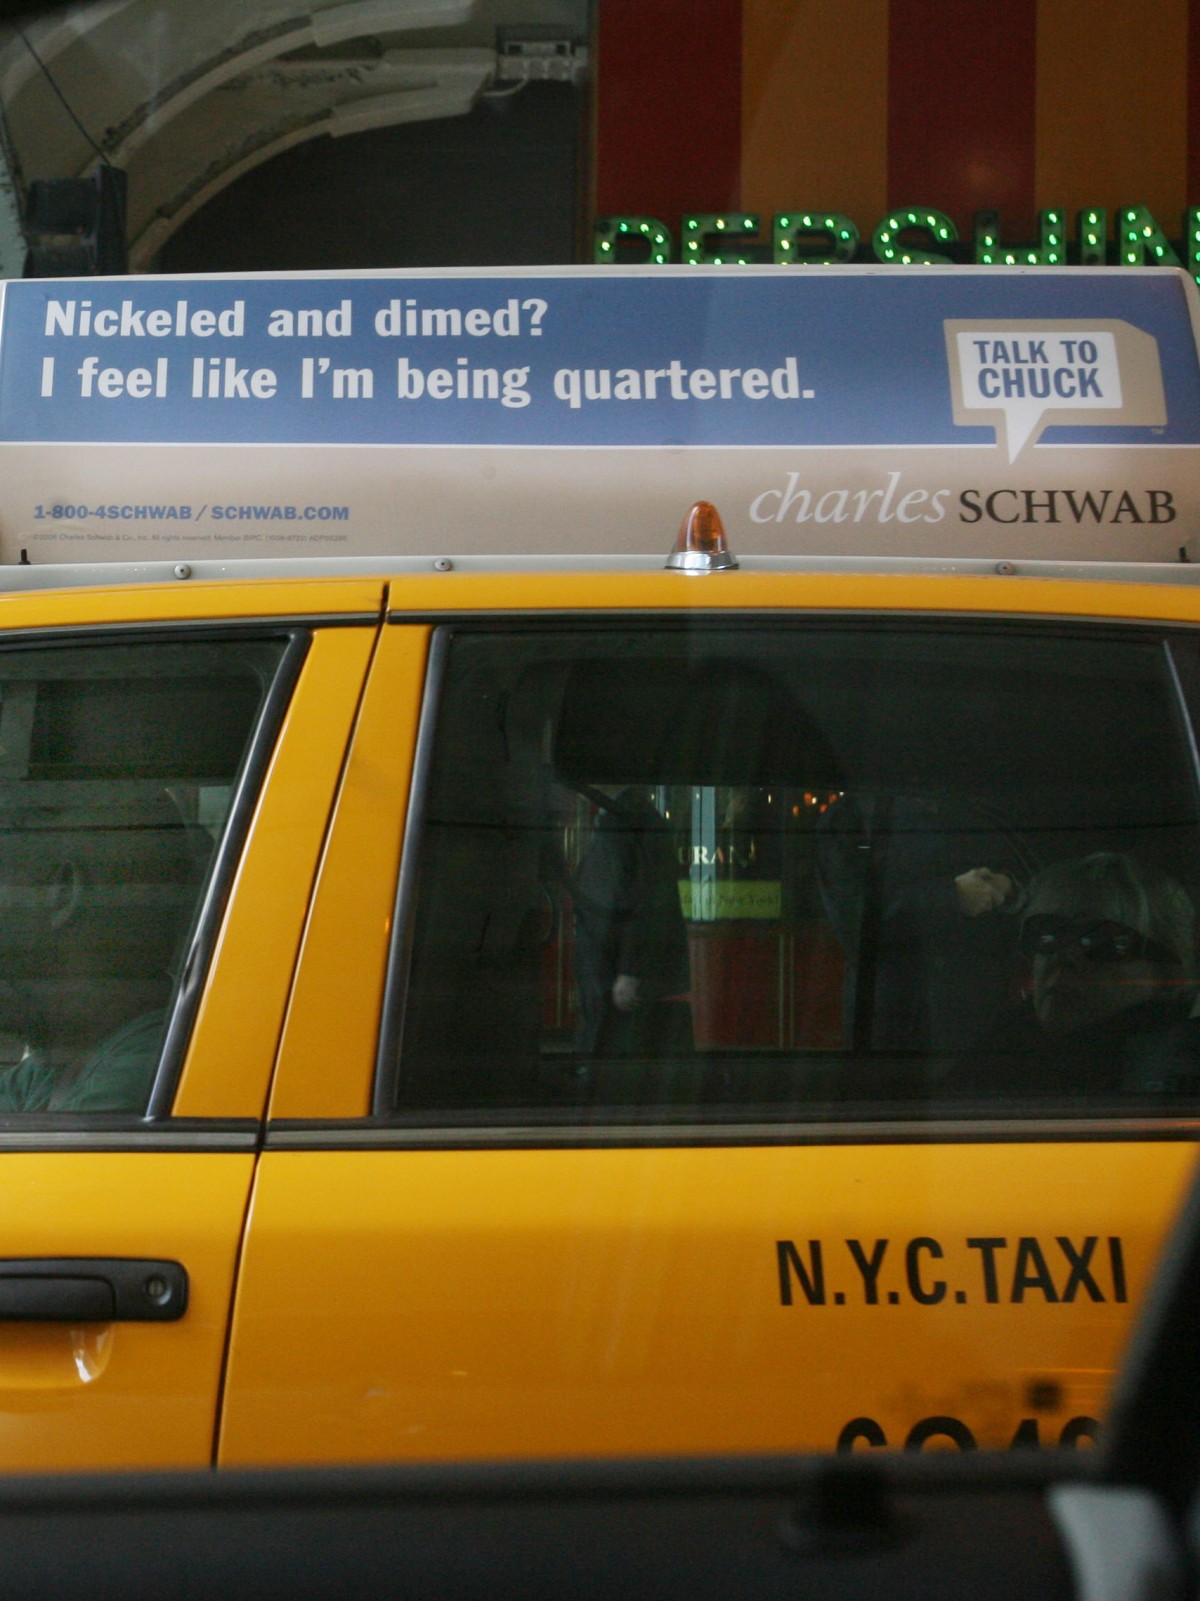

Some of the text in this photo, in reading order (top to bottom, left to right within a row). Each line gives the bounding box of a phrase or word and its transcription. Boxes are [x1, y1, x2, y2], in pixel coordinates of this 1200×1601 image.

[44, 298, 548, 337] Nickeled and dimed?
[973, 339, 1099, 365] TALK TO
[40, 356, 816, 409] I feel like I'm being quartered.
[978, 367, 1104, 399] CHUCK
[34, 504, 193, 520] 1-800-4SCHWAB
[211, 505, 349, 521] SCHWAB.COM
[749, 472, 1178, 525] charles SCHWAB
